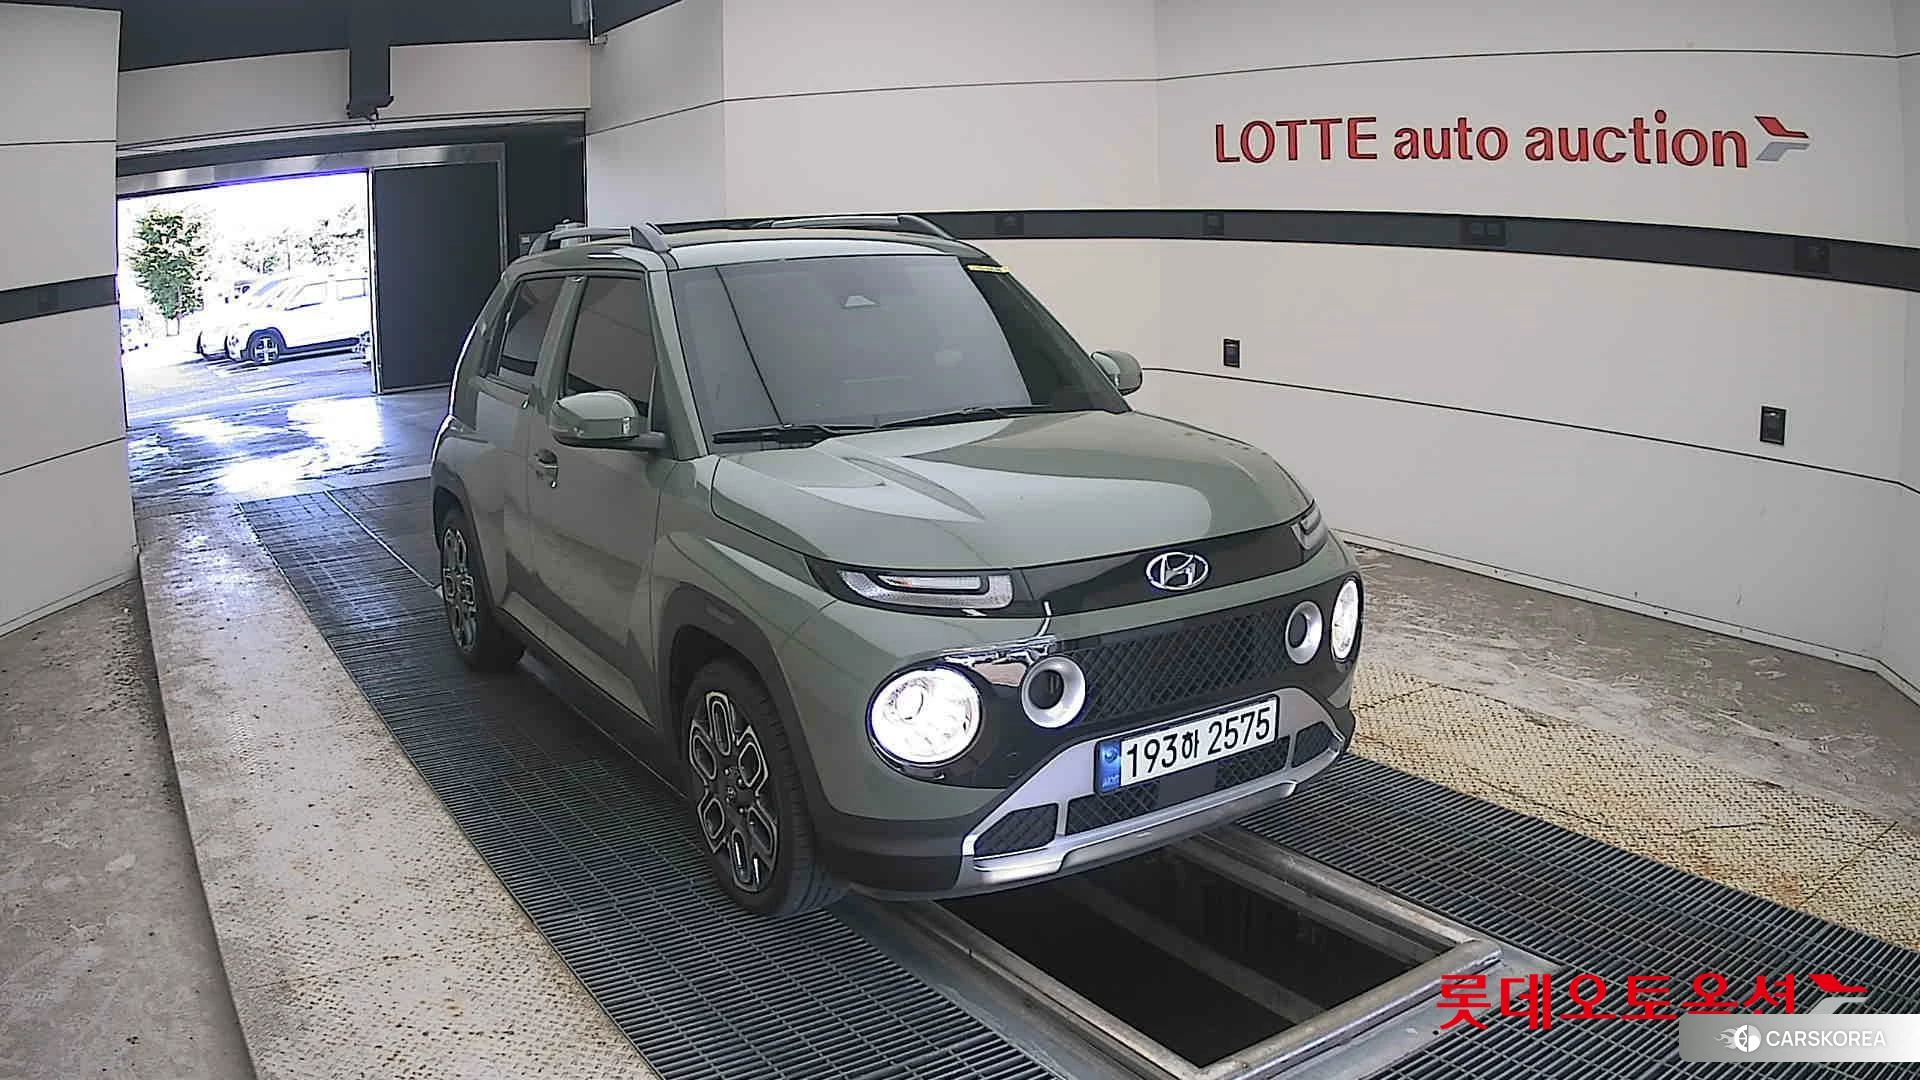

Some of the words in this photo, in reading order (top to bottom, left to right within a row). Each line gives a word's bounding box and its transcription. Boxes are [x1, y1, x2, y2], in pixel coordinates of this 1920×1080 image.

[1215, 116, 1377, 163] LOTTE
[1393, 117, 1509, 161] auto
[1524, 110, 1749, 169] auction
[1126, 729, 1200, 778] 193하
[1207, 706, 1271, 756] 2575
